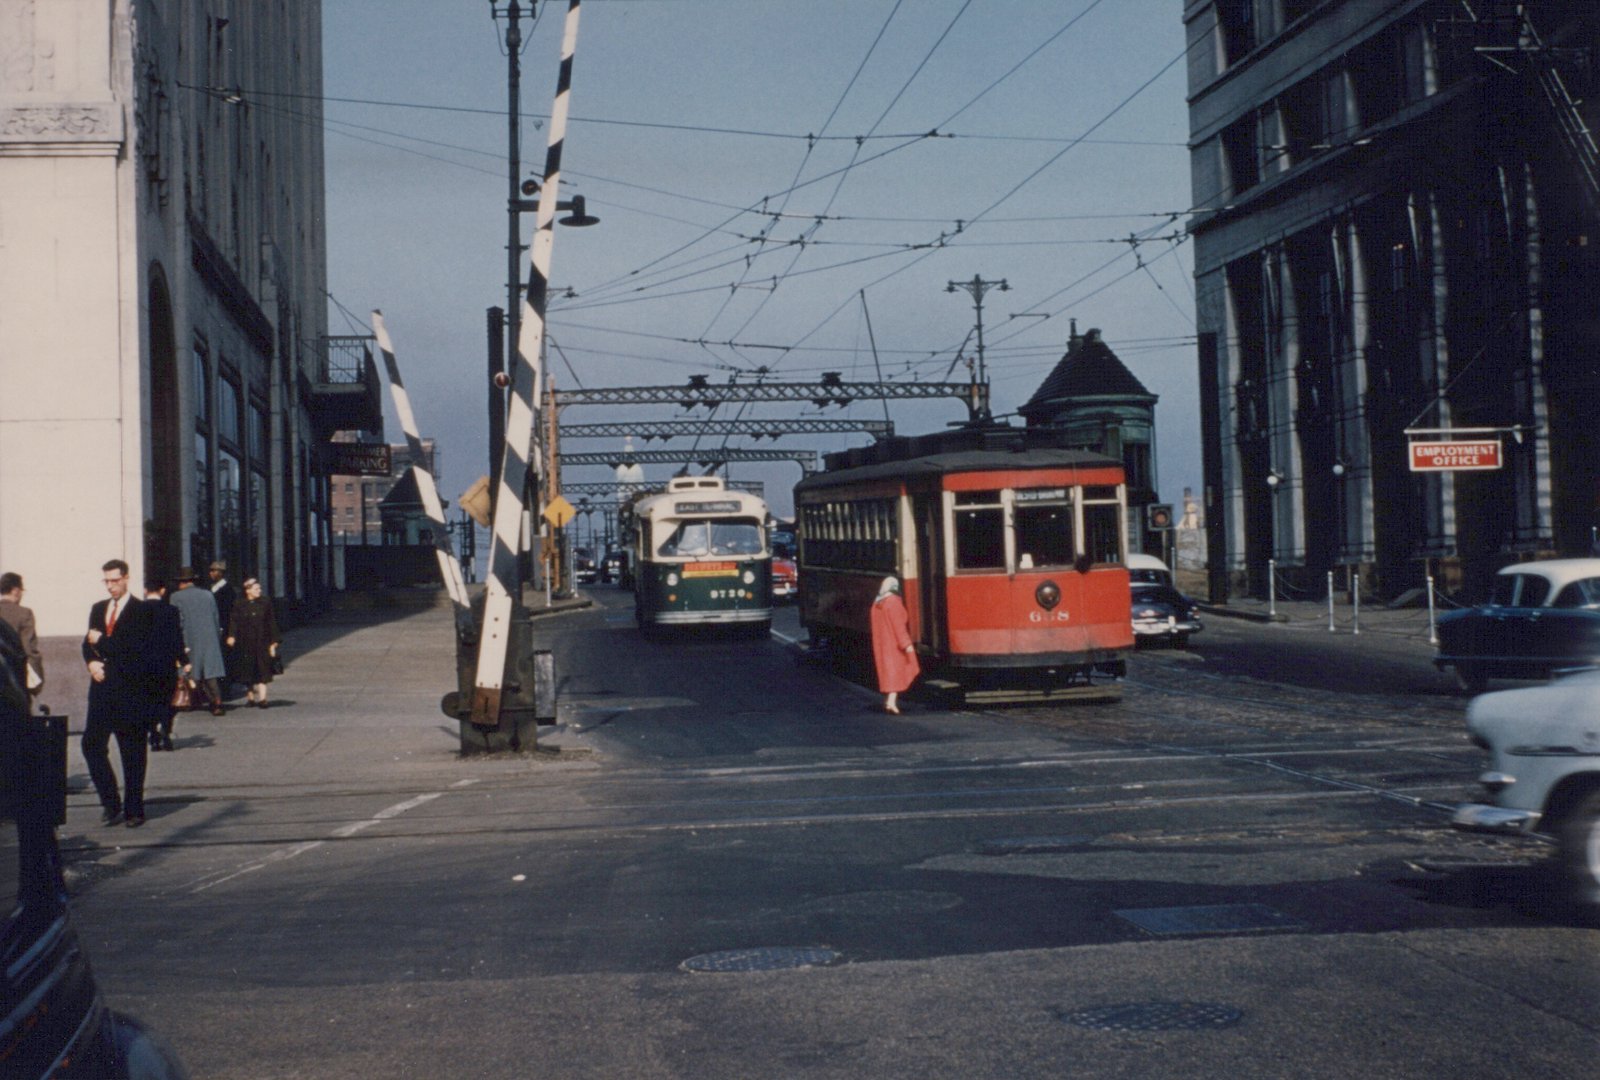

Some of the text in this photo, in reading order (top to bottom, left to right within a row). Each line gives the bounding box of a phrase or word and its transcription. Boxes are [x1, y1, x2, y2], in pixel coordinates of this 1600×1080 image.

[1416, 445, 1495, 457] EMPLOYMENT
[340, 457, 387, 469] PARKING
[1432, 455, 1479, 465] OFFICE
